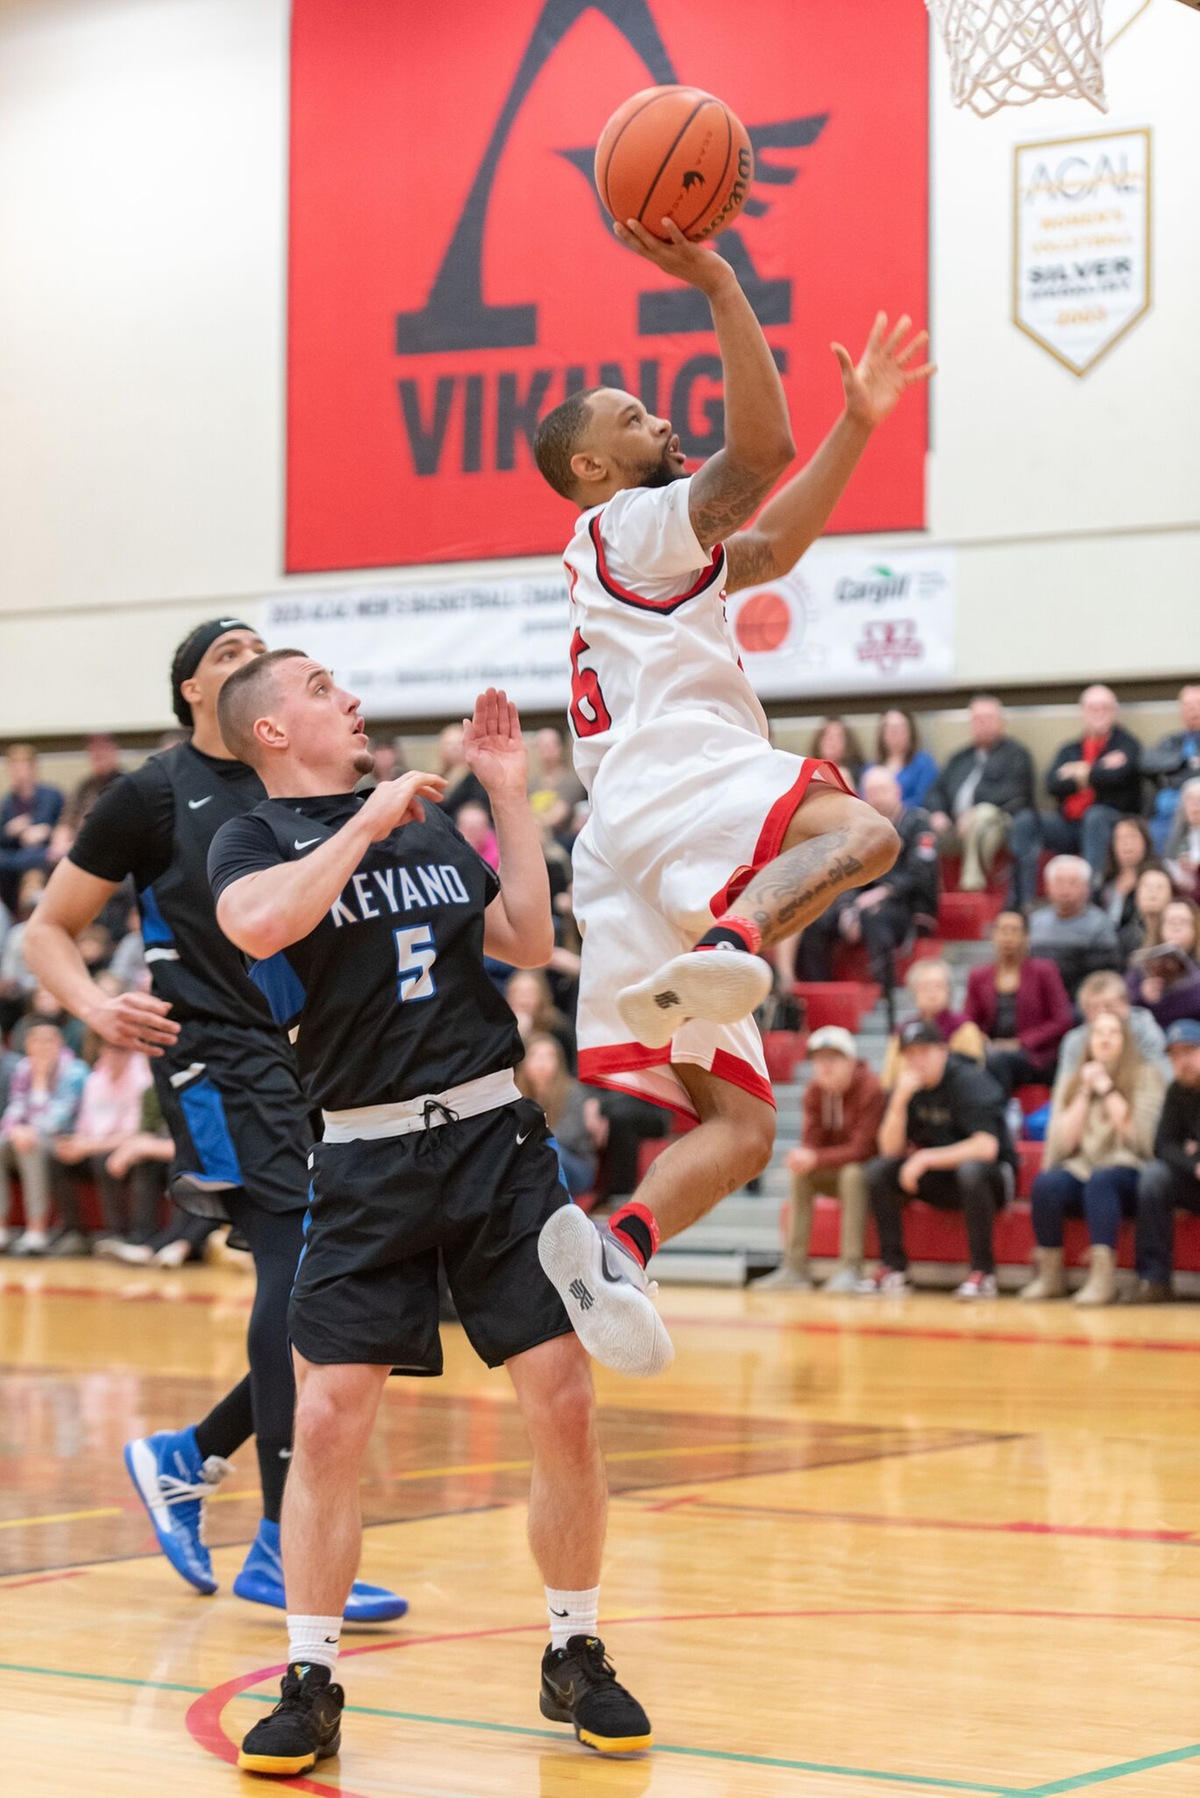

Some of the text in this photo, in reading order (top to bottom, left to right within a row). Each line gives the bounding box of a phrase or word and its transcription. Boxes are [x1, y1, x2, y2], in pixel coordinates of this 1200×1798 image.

[1029, 256, 1131, 283] SILVER
[835, 573, 911, 606] Cargill
[393, 922, 437, 1003] 5
